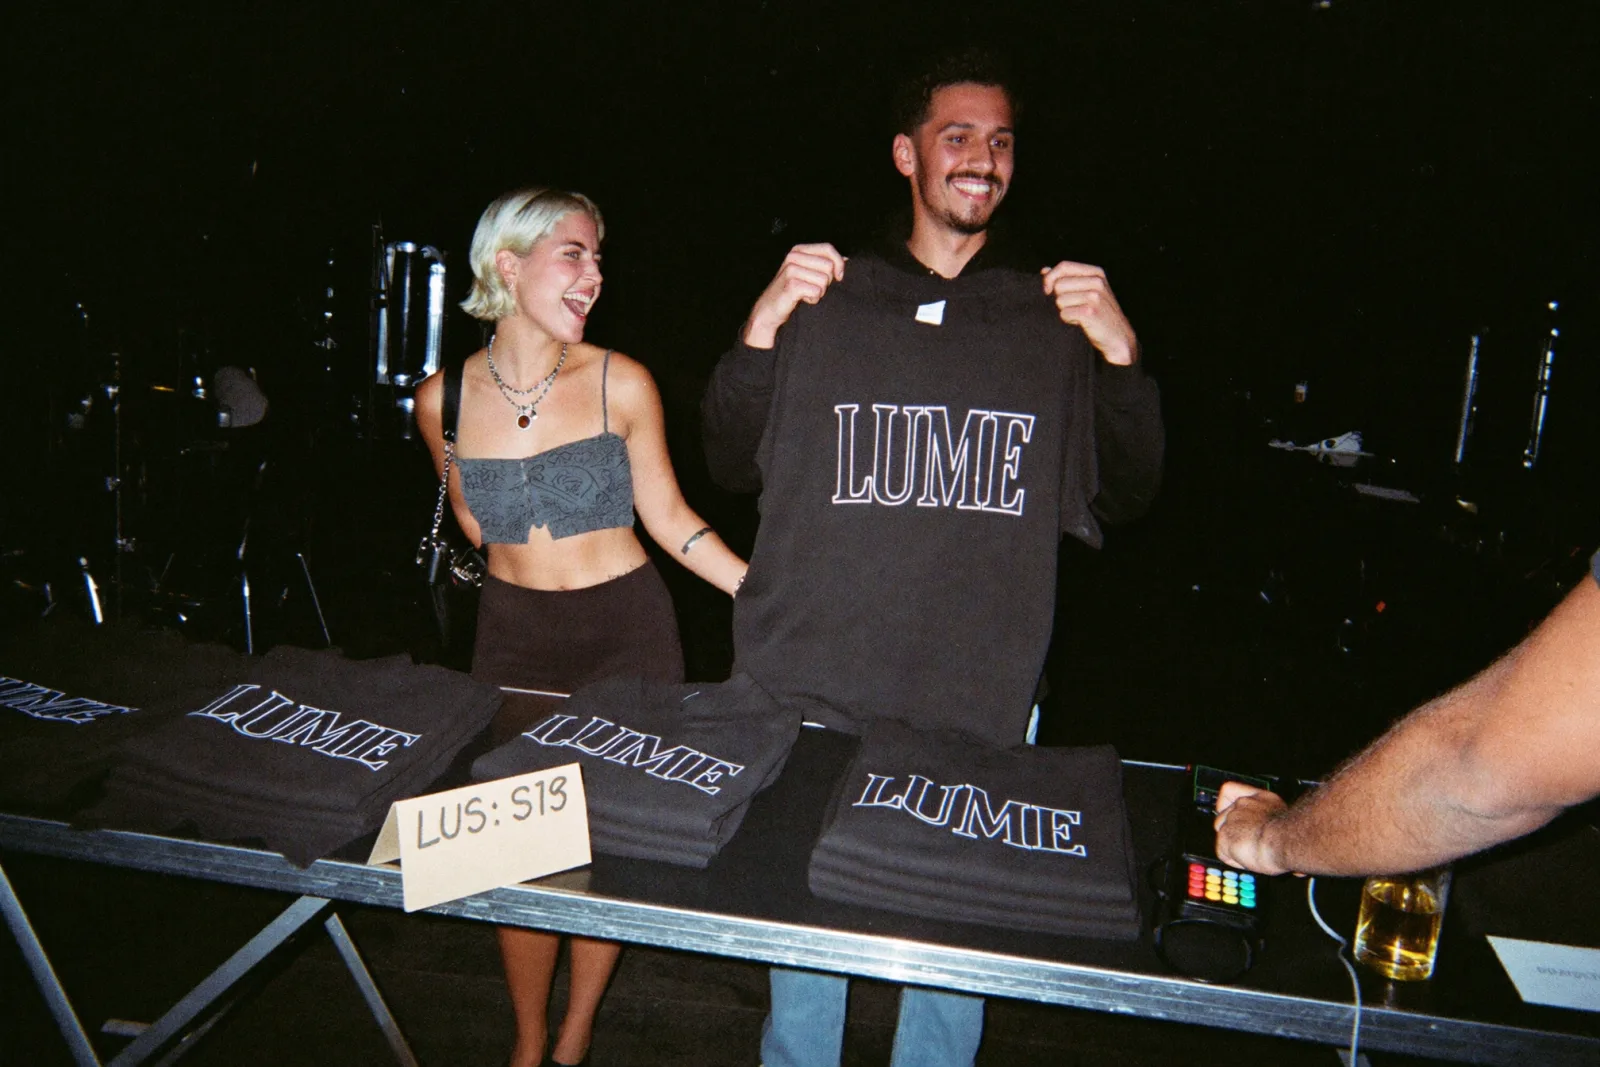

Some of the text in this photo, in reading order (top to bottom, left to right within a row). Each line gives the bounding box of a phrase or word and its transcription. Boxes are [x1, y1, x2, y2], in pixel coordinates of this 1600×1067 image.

[832, 404, 1036, 516] LUME
[187, 684, 422, 771] LUME
[521, 714, 745, 796] LUME
[417, 796, 500, 849] LUS:
[851, 773, 1087, 857] LUME
